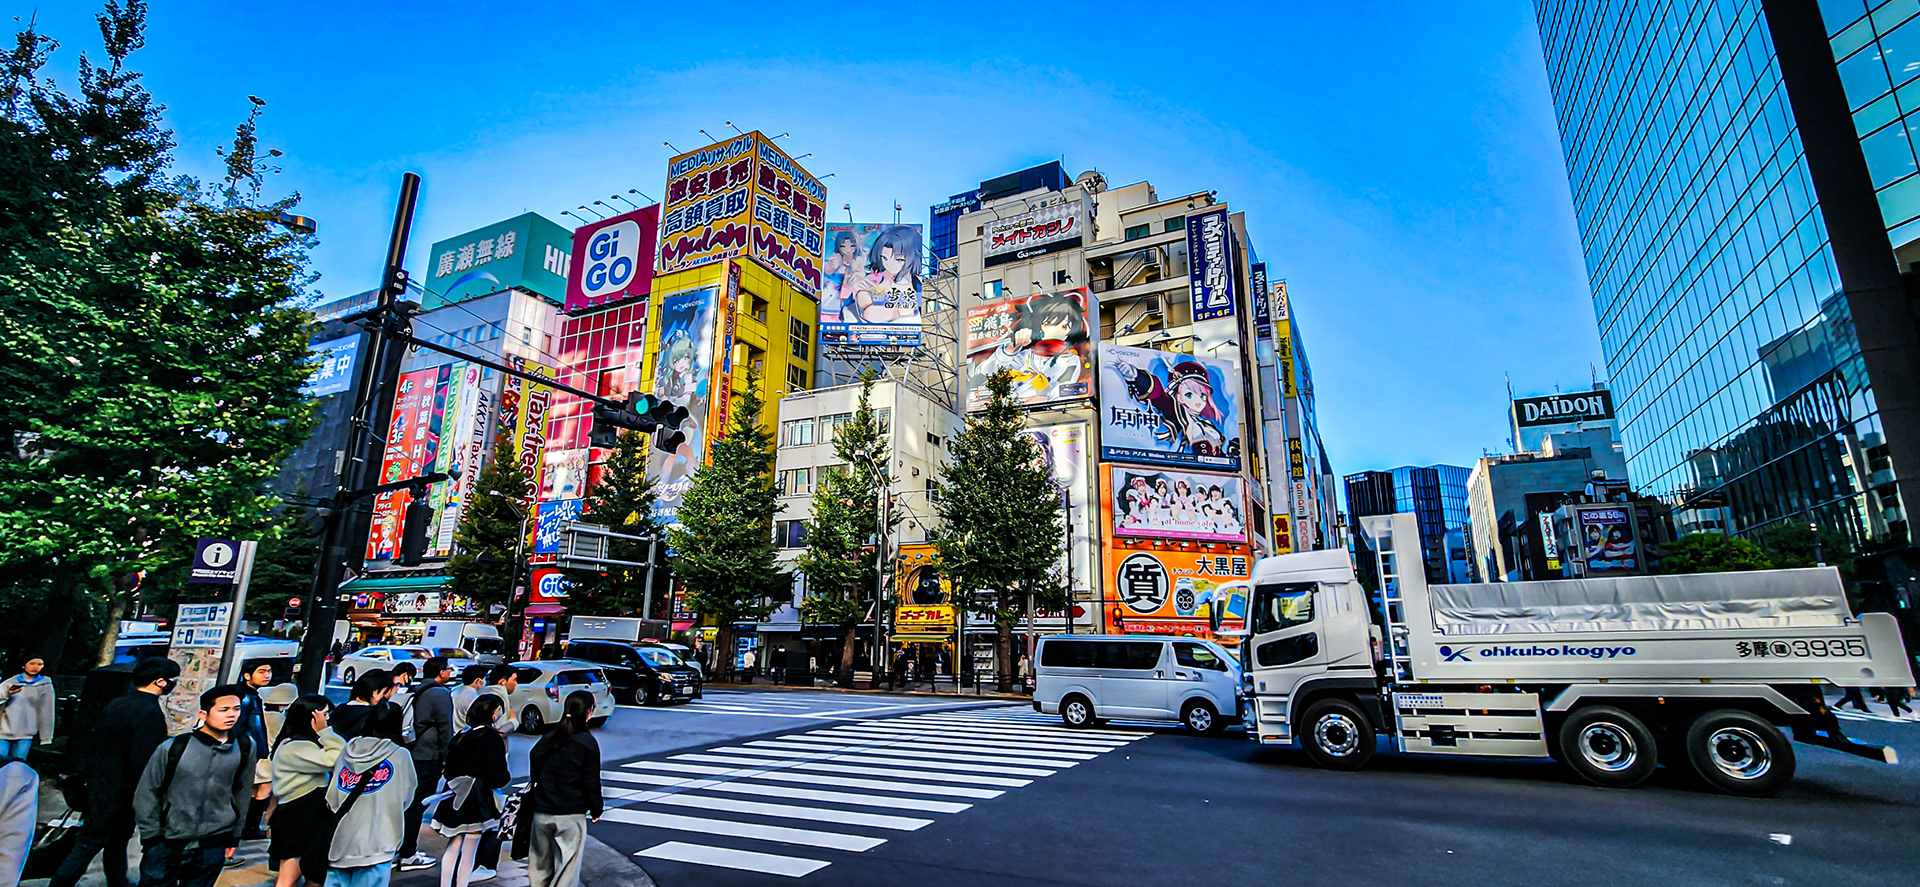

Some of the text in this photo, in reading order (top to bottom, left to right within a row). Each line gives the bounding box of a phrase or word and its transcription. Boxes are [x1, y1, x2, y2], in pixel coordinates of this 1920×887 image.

[671, 136, 752, 178] MEDIAリサイクル
[759, 141, 824, 200] MEDIAリサイクル
[669, 158, 751, 204] 激安販売
[665, 188, 747, 236] 高額買取
[755, 195, 820, 255] 高額買取
[435, 231, 517, 278] 廣瀬無線
[662, 223, 747, 270] Mulan
[991, 217, 1075, 250] メイドカジノ
[753, 226, 821, 289] Mulan
[399, 379, 414, 394] 4F
[474, 391, 489, 428] AKKY
[1110, 400, 1160, 437] 原神
[390, 429, 404, 444] 3F
[520, 391, 549, 479] Tax-free
[1124, 563, 1166, 606] 質
[1196, 556, 1247, 577] 大黒屋
[1479, 645, 1637, 660] ohkubo kogyo
[1791, 640, 1866, 658] 3935
